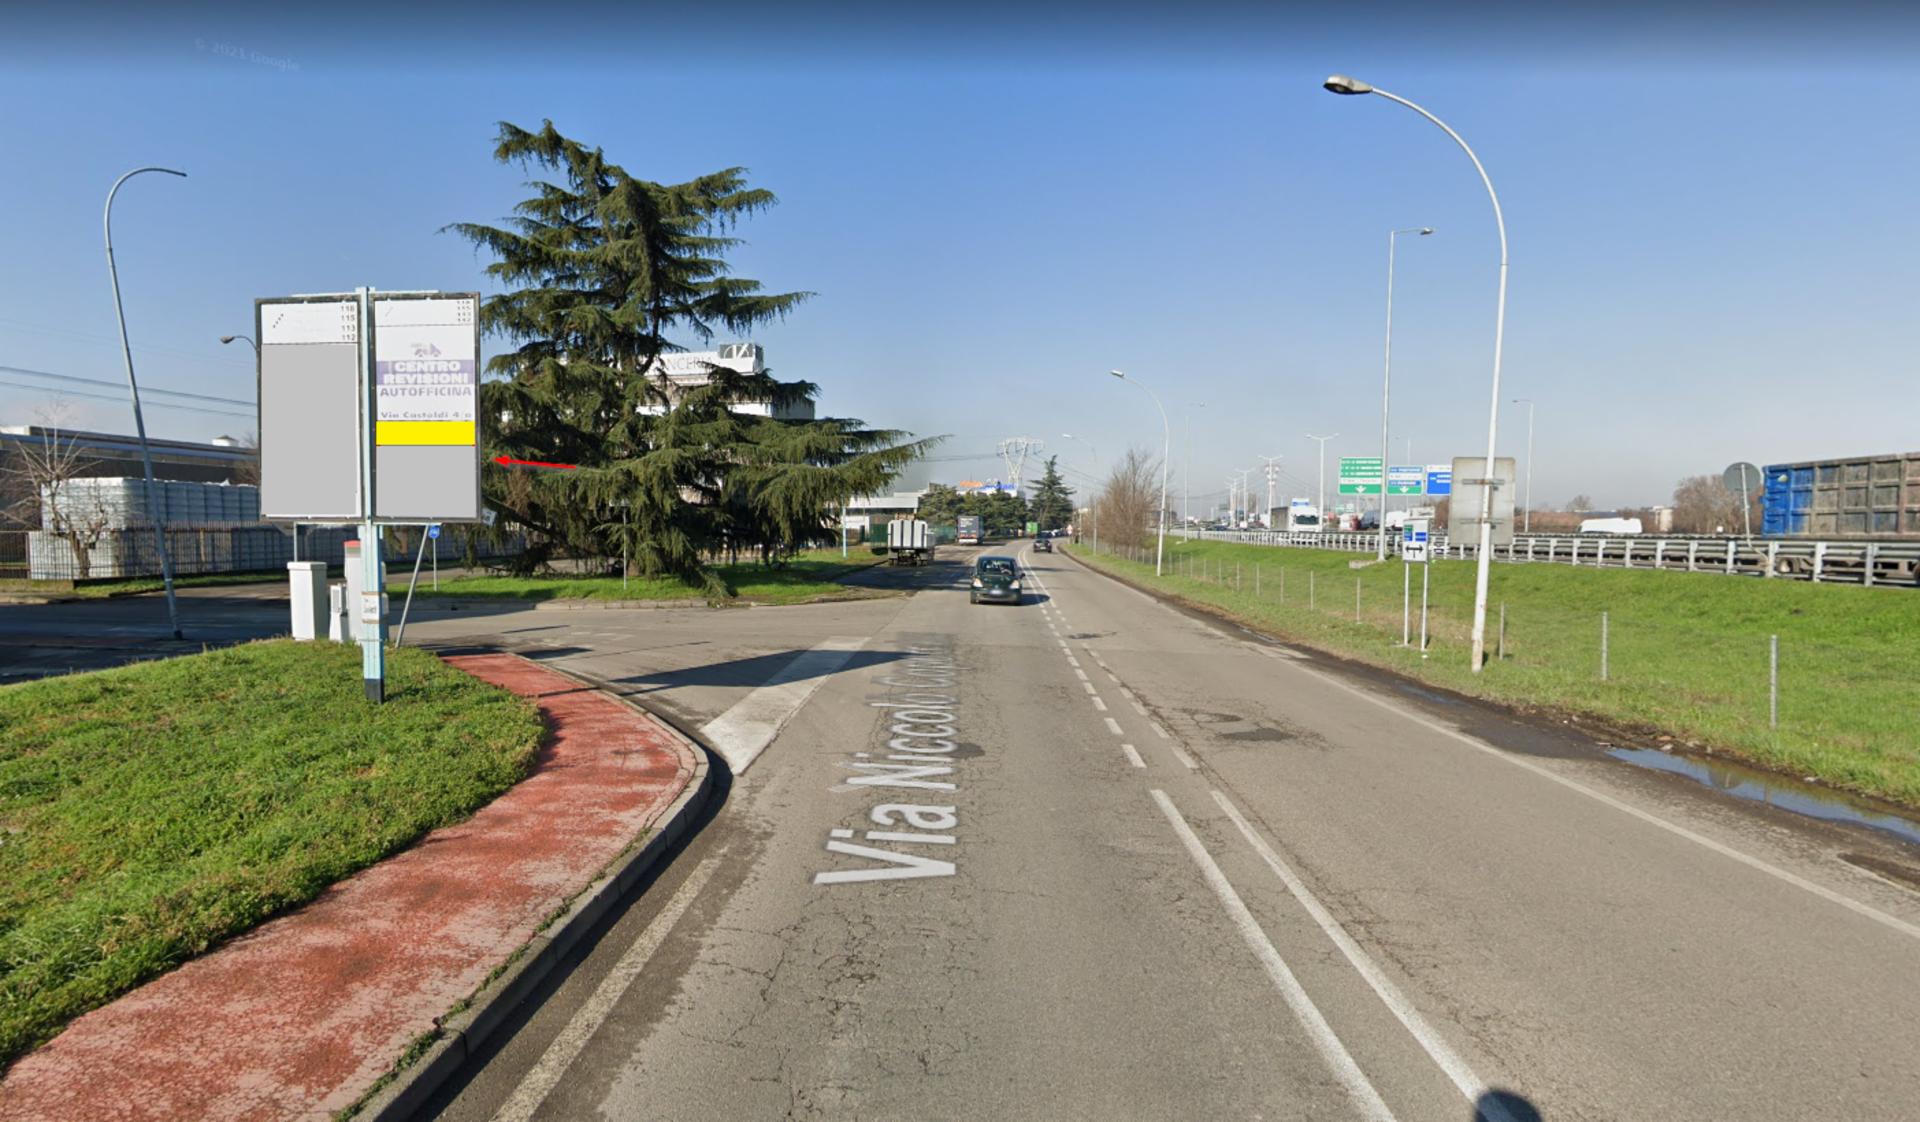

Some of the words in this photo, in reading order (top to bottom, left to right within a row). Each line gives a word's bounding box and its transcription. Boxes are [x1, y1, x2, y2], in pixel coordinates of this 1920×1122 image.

[394, 360, 461, 373] CENTRO
[383, 373, 469, 385] REVISIONI
[380, 386, 472, 397] AUTOFFICINA
[381, 411, 399, 419] Via
